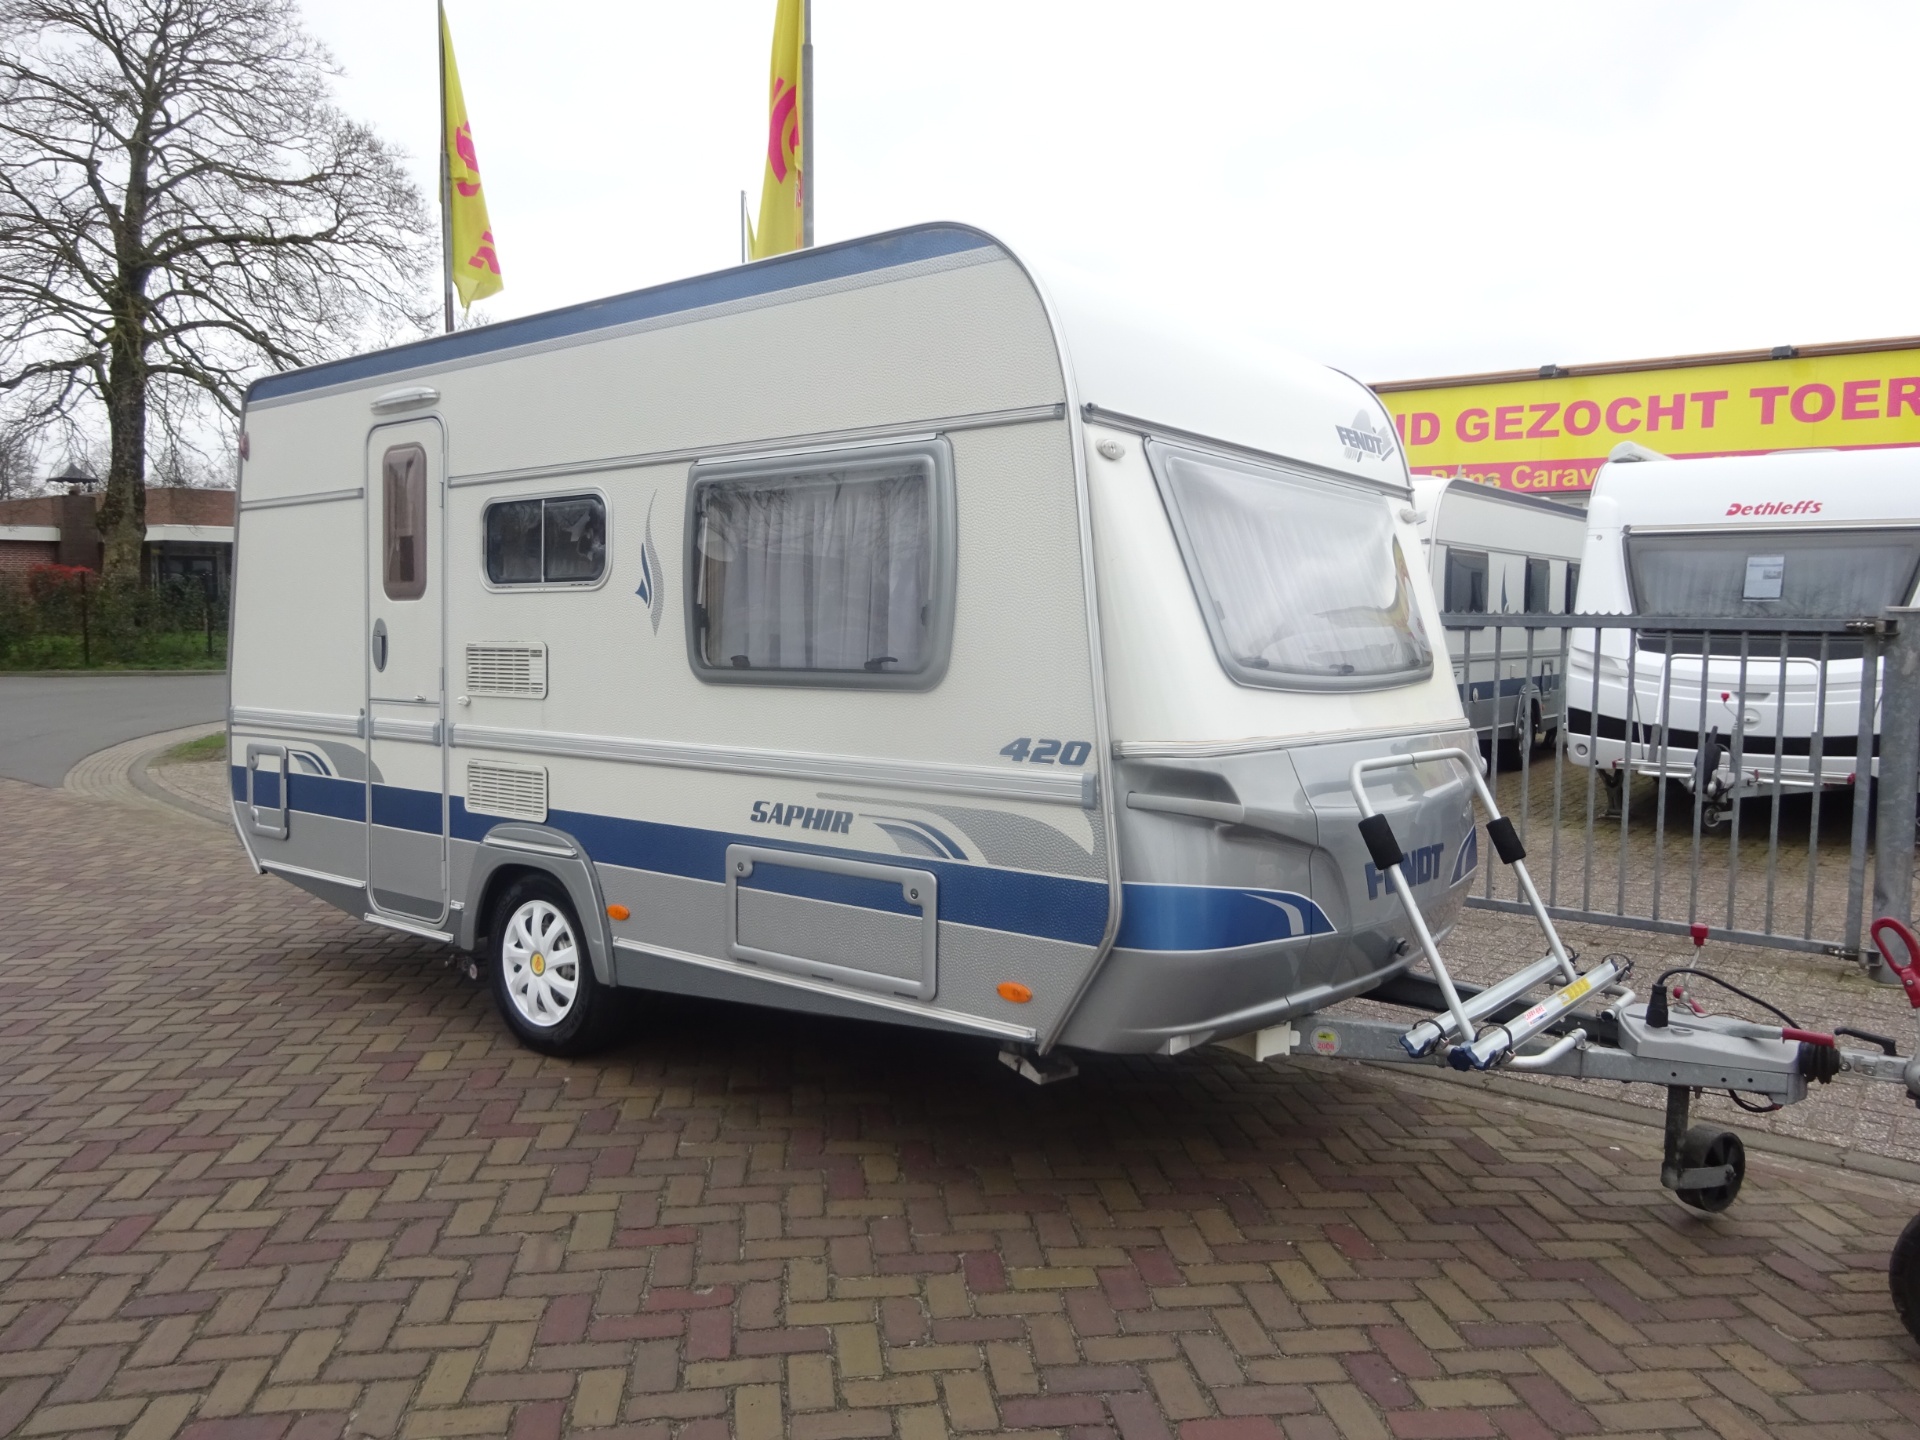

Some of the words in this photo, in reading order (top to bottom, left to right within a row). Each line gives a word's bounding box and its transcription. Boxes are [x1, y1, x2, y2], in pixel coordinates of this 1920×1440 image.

[1455, 390, 1729, 443] GEZOCHT
[1749, 376, 1920, 425] TOER
[1335, 424, 1383, 456] FENDT
[1510, 464, 1599, 489] Carav
[1725, 500, 1823, 516] Dethleffs
[999, 737, 1092, 766] 420
[750, 800, 853, 834] SAPHIR
